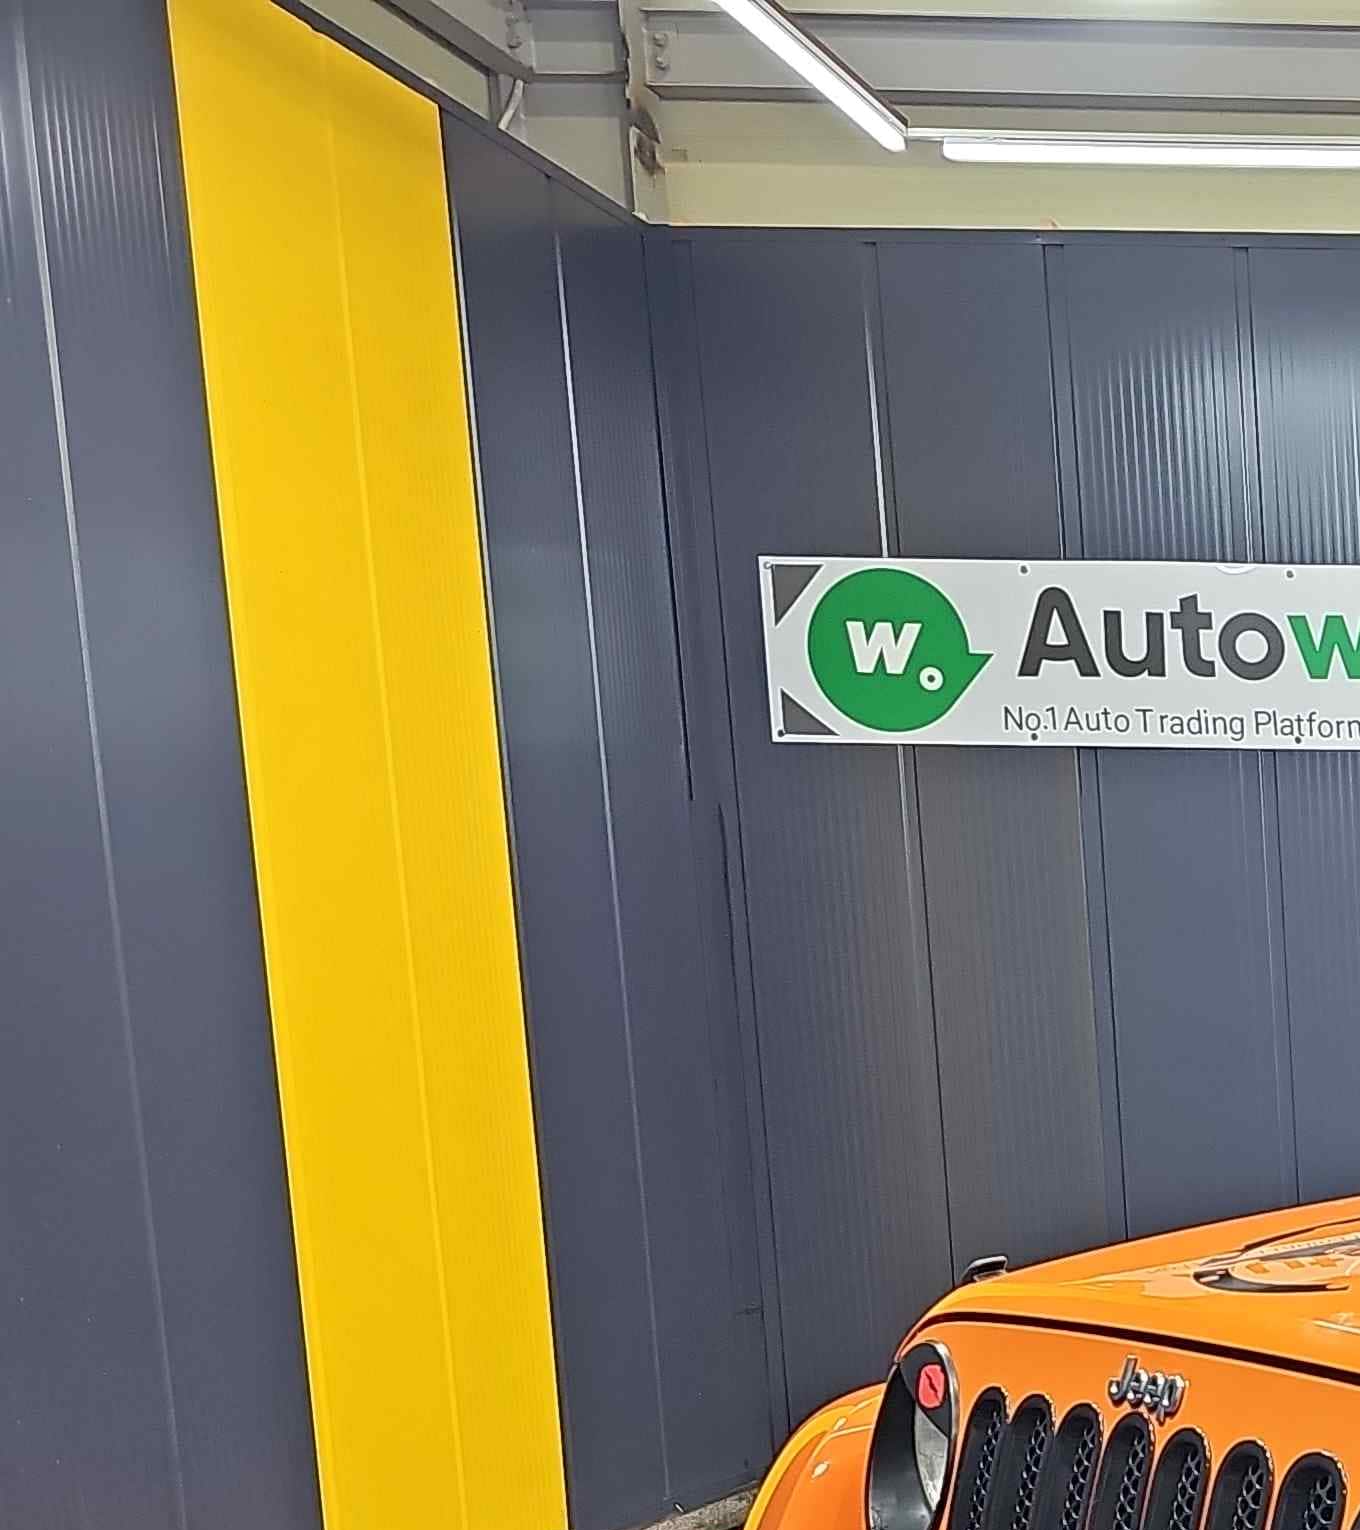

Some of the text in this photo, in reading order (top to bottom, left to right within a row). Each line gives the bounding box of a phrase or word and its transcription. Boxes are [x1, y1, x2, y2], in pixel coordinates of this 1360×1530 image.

[1004, 707, 1057, 731] No.1
[1064, 707, 1130, 733] Auto
[1135, 708, 1245, 742] Trading
[1108, 1355, 1189, 1426] Jeep
